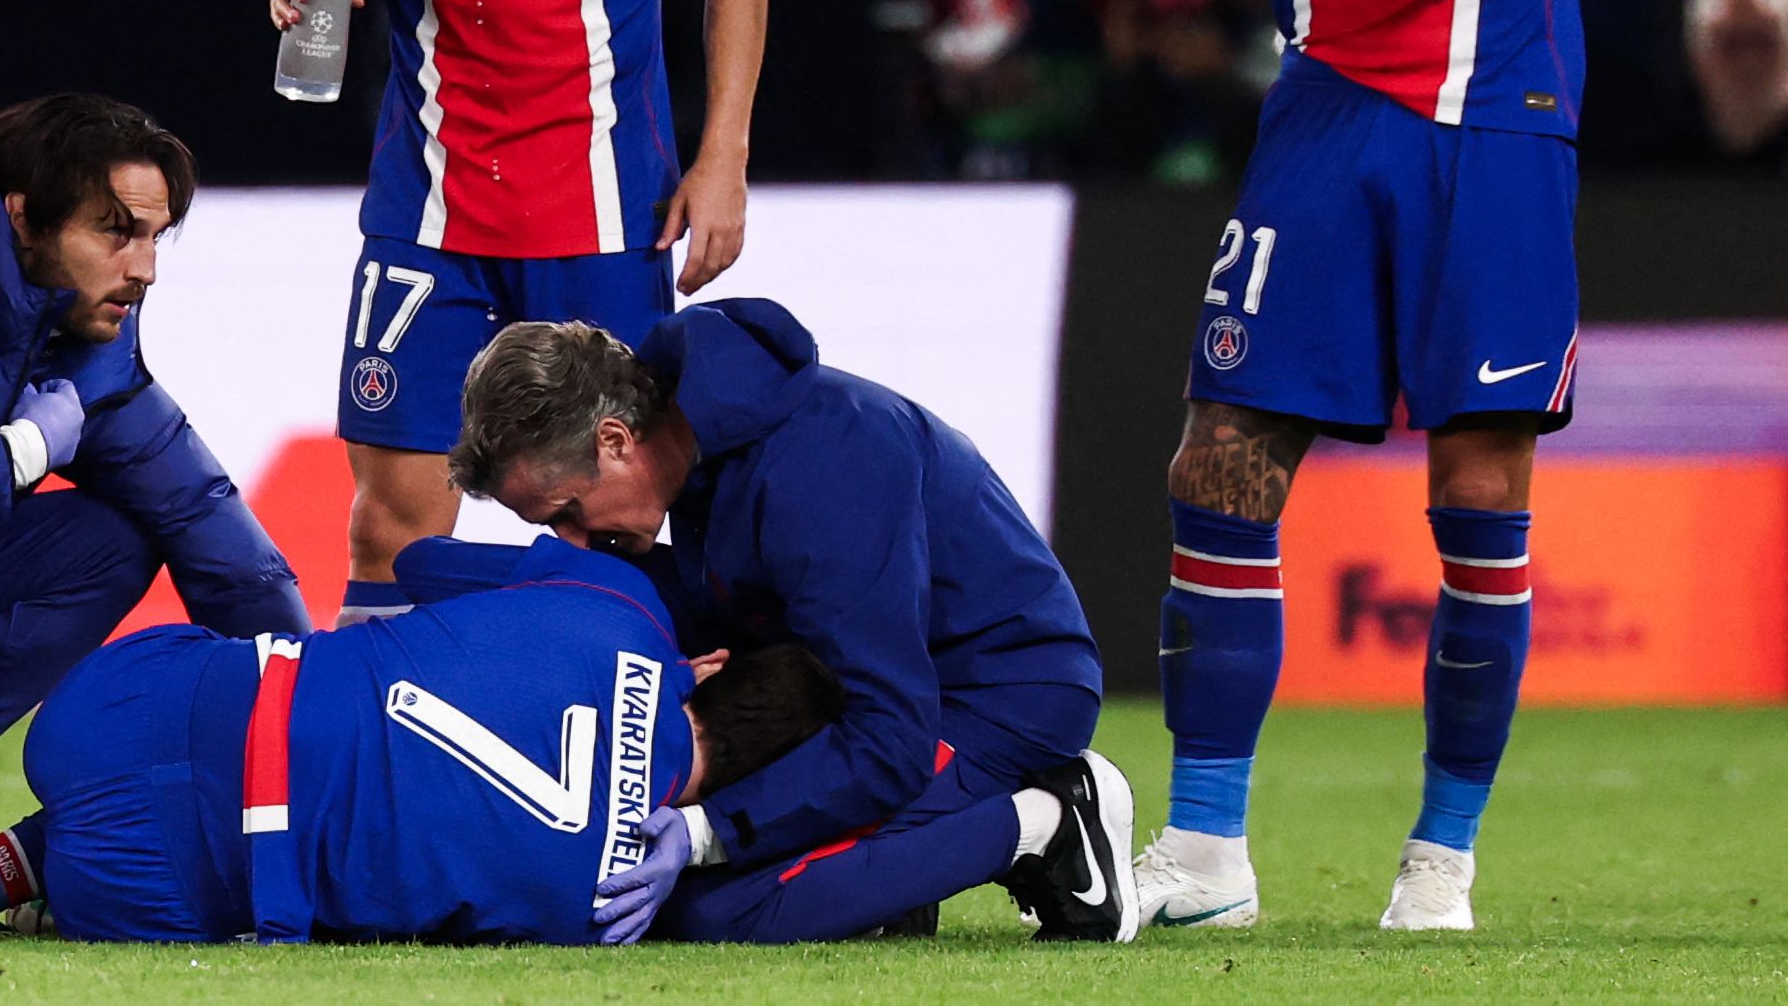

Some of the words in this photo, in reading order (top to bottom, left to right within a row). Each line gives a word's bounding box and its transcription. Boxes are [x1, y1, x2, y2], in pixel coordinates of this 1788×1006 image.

[353, 261, 434, 352] 17
[1204, 219, 1276, 314] 21
[359, 359, 389, 374] PARIS
[387, 680, 597, 833] 7
[607, 661, 653, 878] KVARATSKHEL
